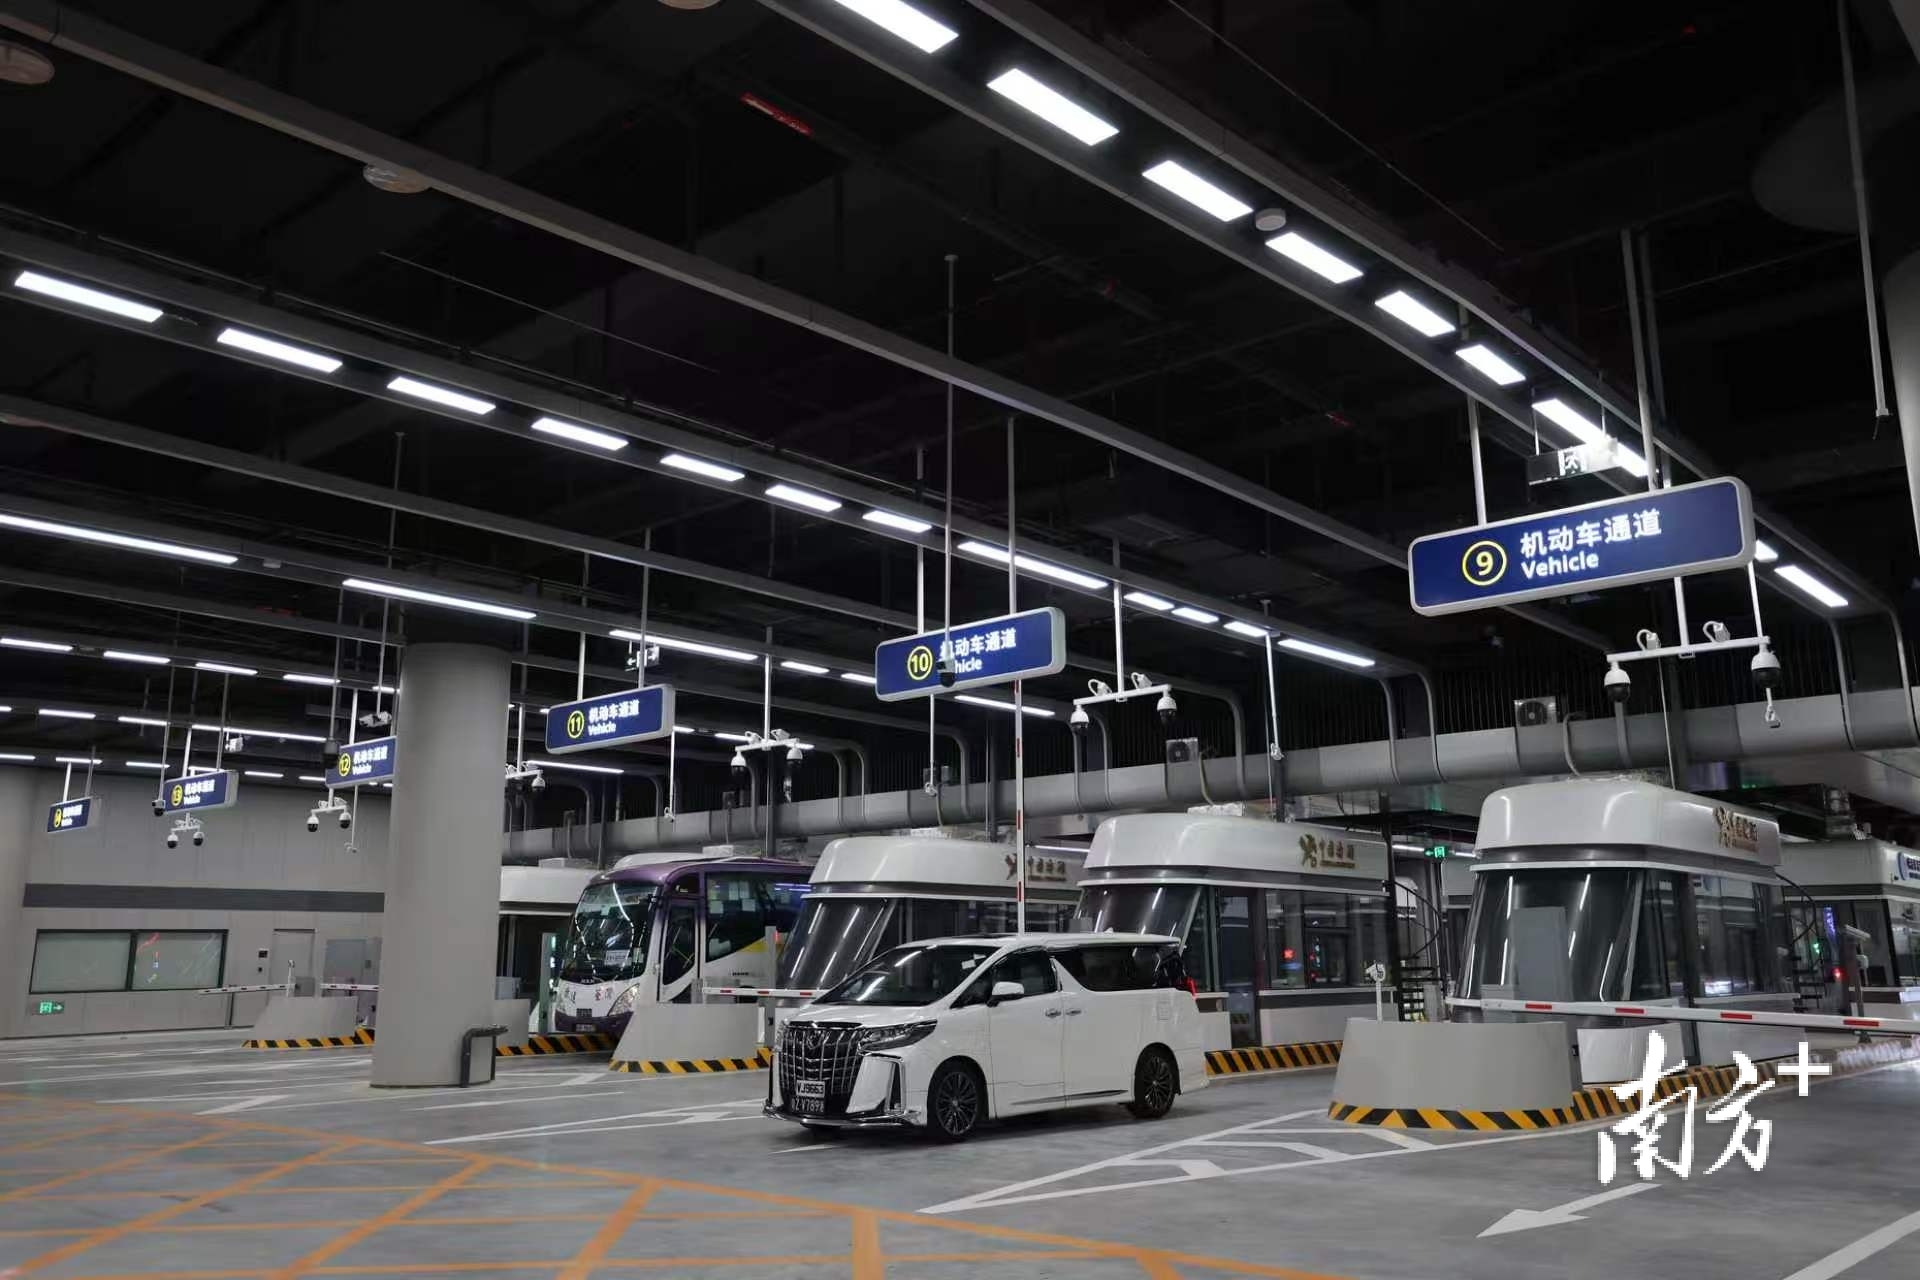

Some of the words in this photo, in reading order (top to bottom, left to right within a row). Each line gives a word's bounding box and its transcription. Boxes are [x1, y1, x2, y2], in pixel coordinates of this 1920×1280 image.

[1519, 508, 1662, 558] 机动车通道
[1520, 551, 1600, 580] Vehicle
[588, 699, 640, 723] 机动车通道
[587, 721, 617, 736] Vehicle
